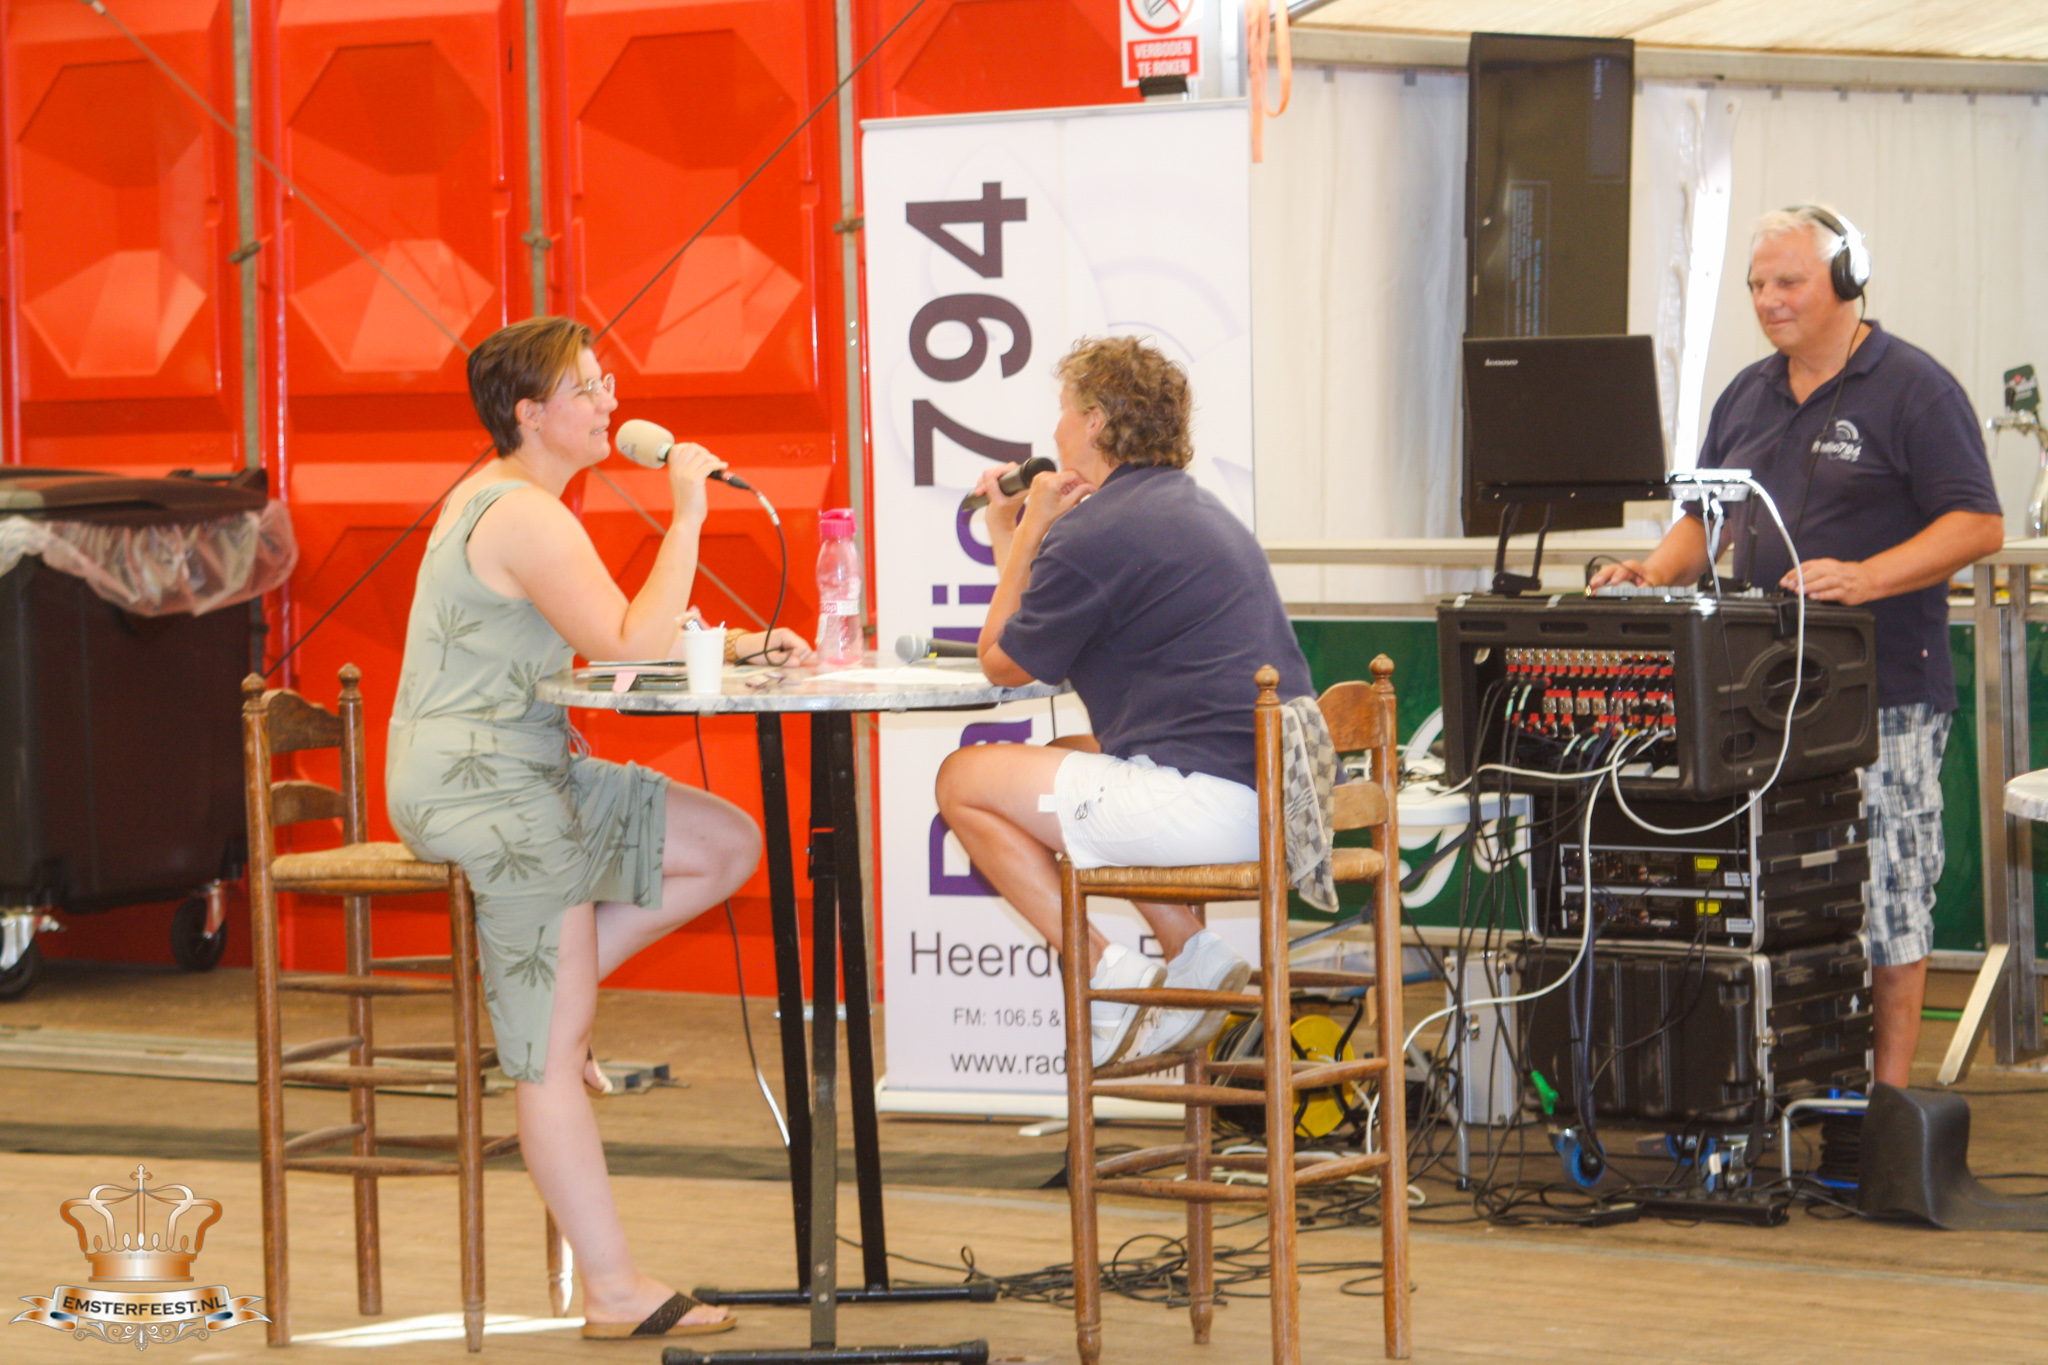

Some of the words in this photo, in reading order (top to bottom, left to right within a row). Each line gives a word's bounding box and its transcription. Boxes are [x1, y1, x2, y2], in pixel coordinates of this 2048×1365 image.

[1133, 40, 1192, 60] VERBODEN
[1137, 61, 1152, 77] TE
[1152, 58, 1190, 76] ROKEN
[910, 931, 1063, 977] Heerd
[954, 1008, 987, 1026] FM:
[994, 1009, 1043, 1026] 106.5
[1049, 1010, 1061, 1026] &
